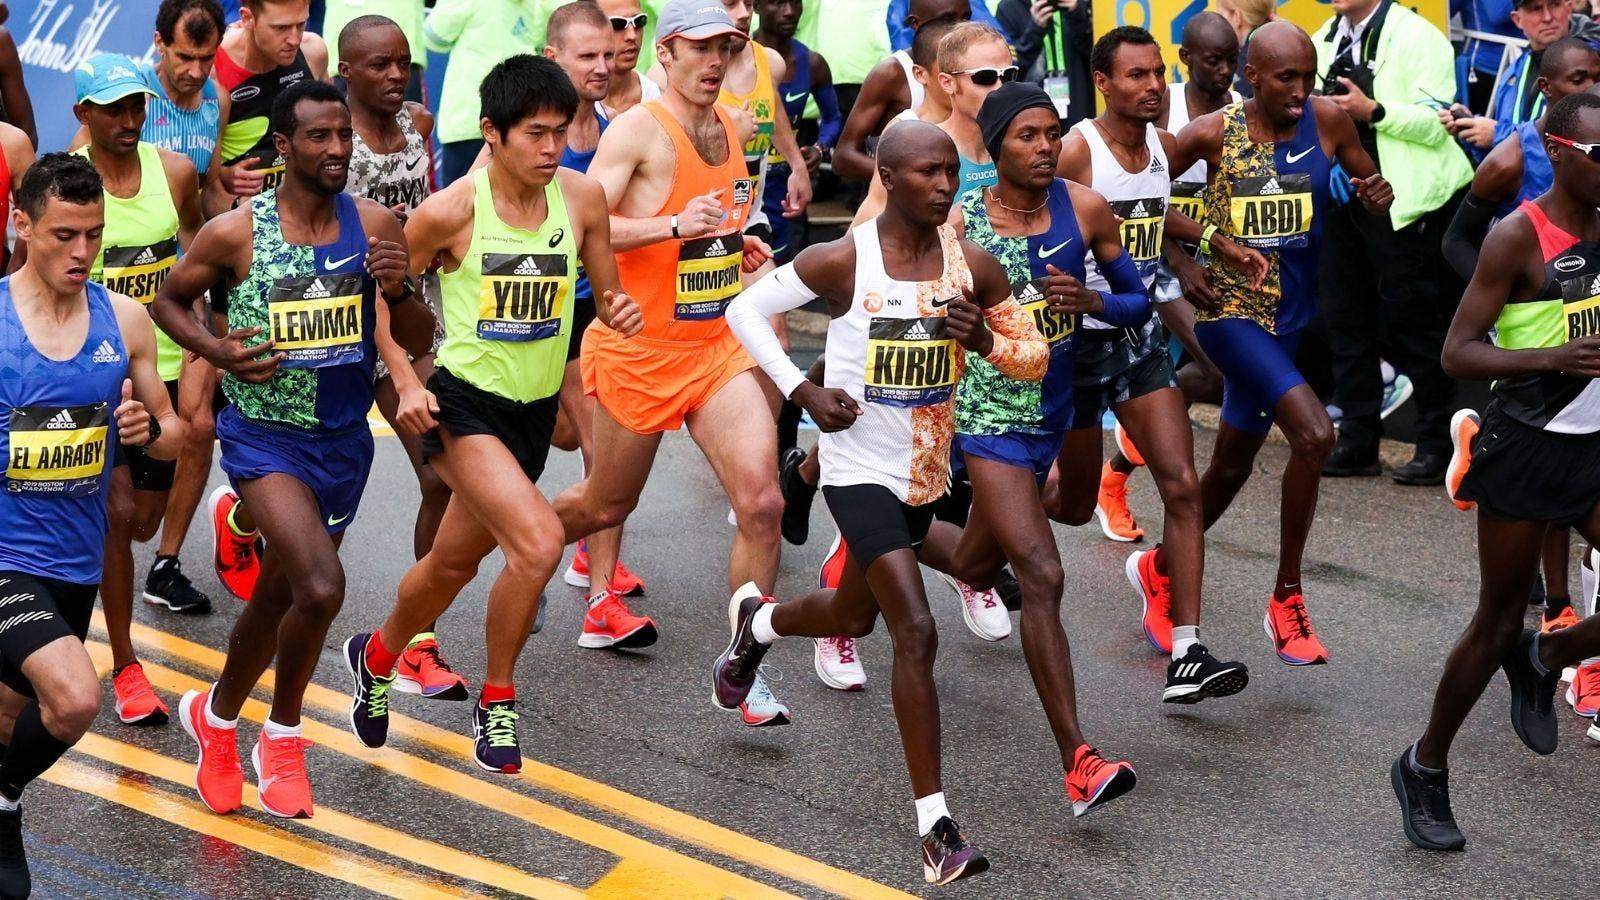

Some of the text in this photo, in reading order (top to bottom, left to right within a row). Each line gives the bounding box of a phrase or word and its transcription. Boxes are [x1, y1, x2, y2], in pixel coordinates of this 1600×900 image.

[279, 71, 304, 84] BROOKS
[367, 176, 426, 209] ARMY
[1130, 211, 1149, 219] adidas
[1242, 198, 1302, 236] ABDI
[705, 248, 728, 257] adidas
[133, 256, 157, 265] adidas
[1557, 259, 1583, 268] HANSONS
[678, 263, 741, 292] THOMPSON
[303, 290, 331, 299] adidas
[493, 280, 559, 320] YUKI
[1018, 293, 1044, 305] adidas
[273, 304, 359, 342] LEMMA
[1033, 304, 1072, 339] ISA
[493, 327, 532, 335] MARATHON
[904, 332, 931, 340] adidas
[93, 353, 121, 363] adidas
[873, 345, 950, 386] KIRUI
[47, 421, 77, 429] adidas
[13, 439, 103, 470] EL AARABY
